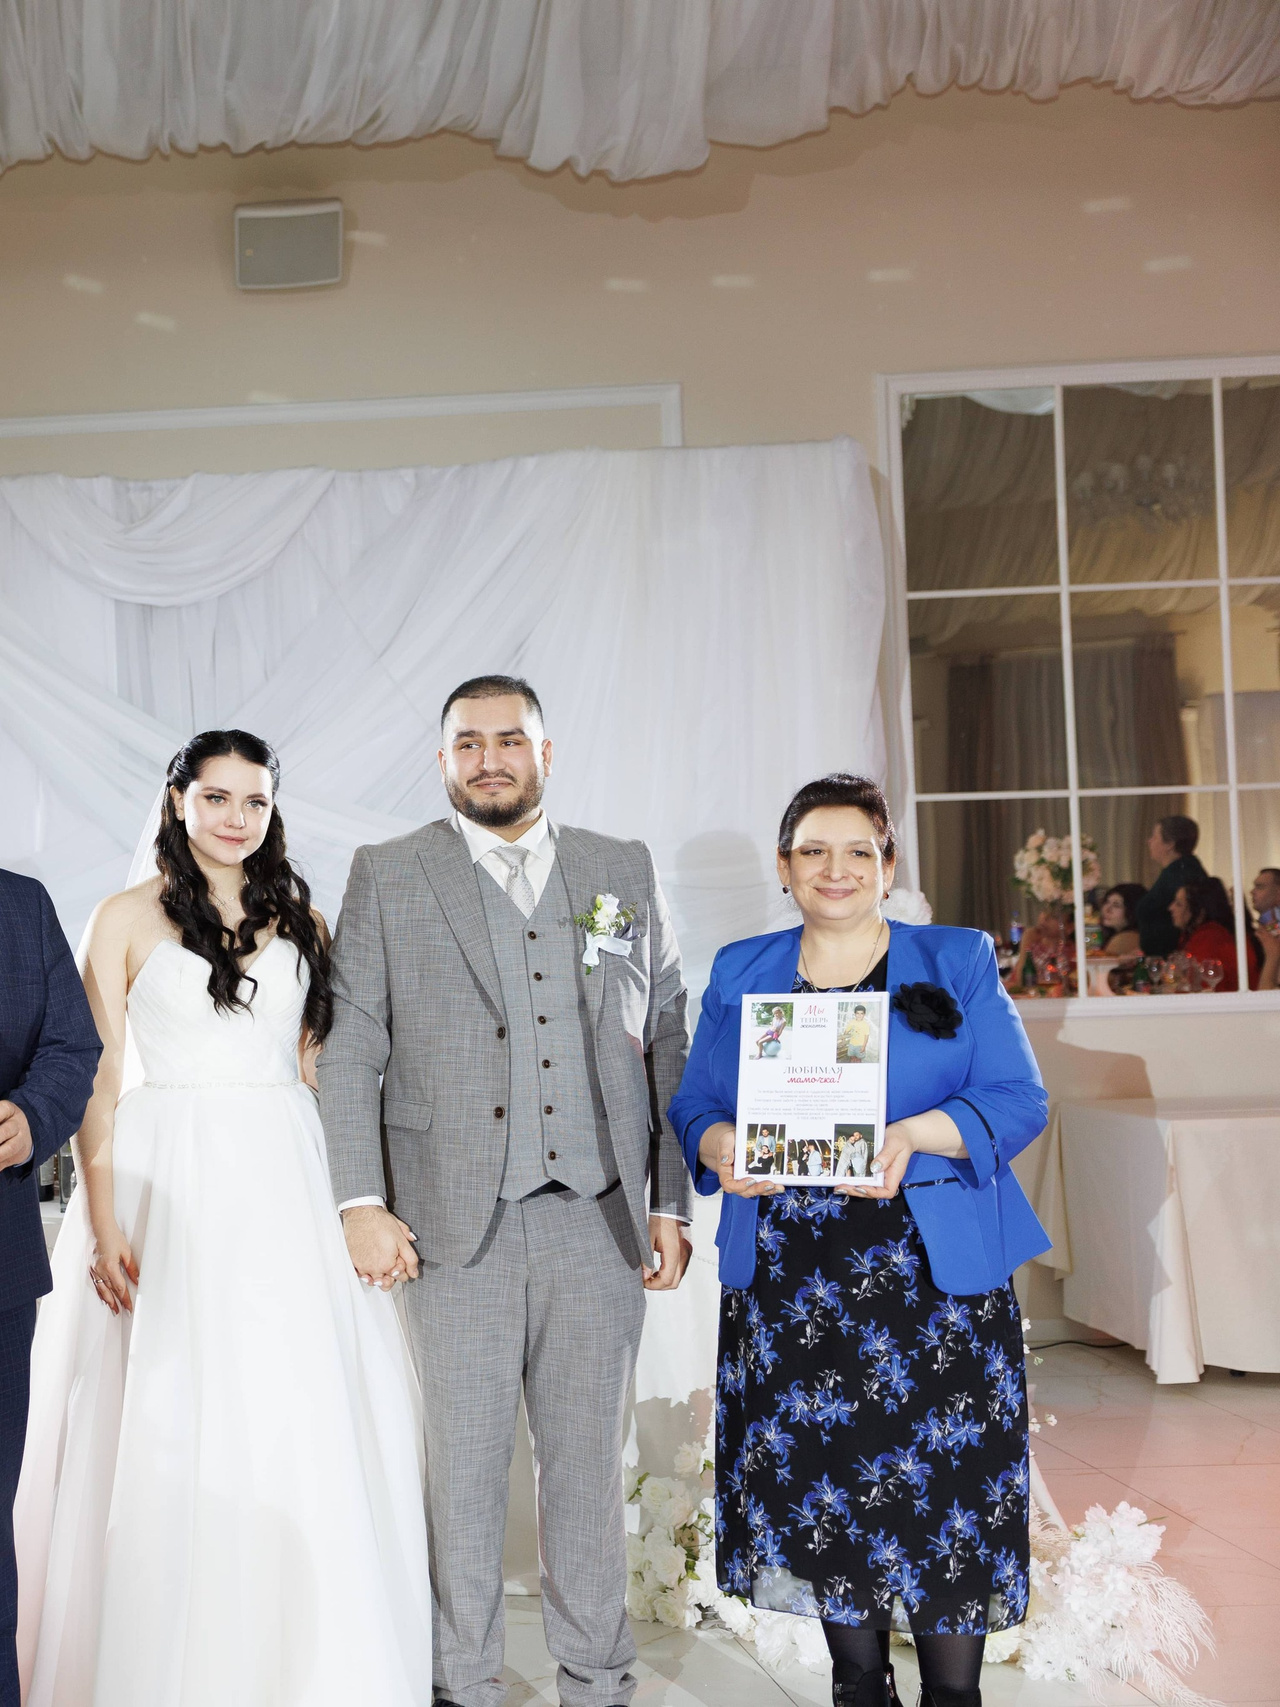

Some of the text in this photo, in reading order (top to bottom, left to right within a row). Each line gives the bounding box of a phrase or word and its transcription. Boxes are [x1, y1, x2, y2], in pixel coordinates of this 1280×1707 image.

[804, 1005, 825, 1016] Мы
[784, 1066, 843, 1075] ЛЮБИМАЯ
[787, 1073, 842, 1084] мамочка!
